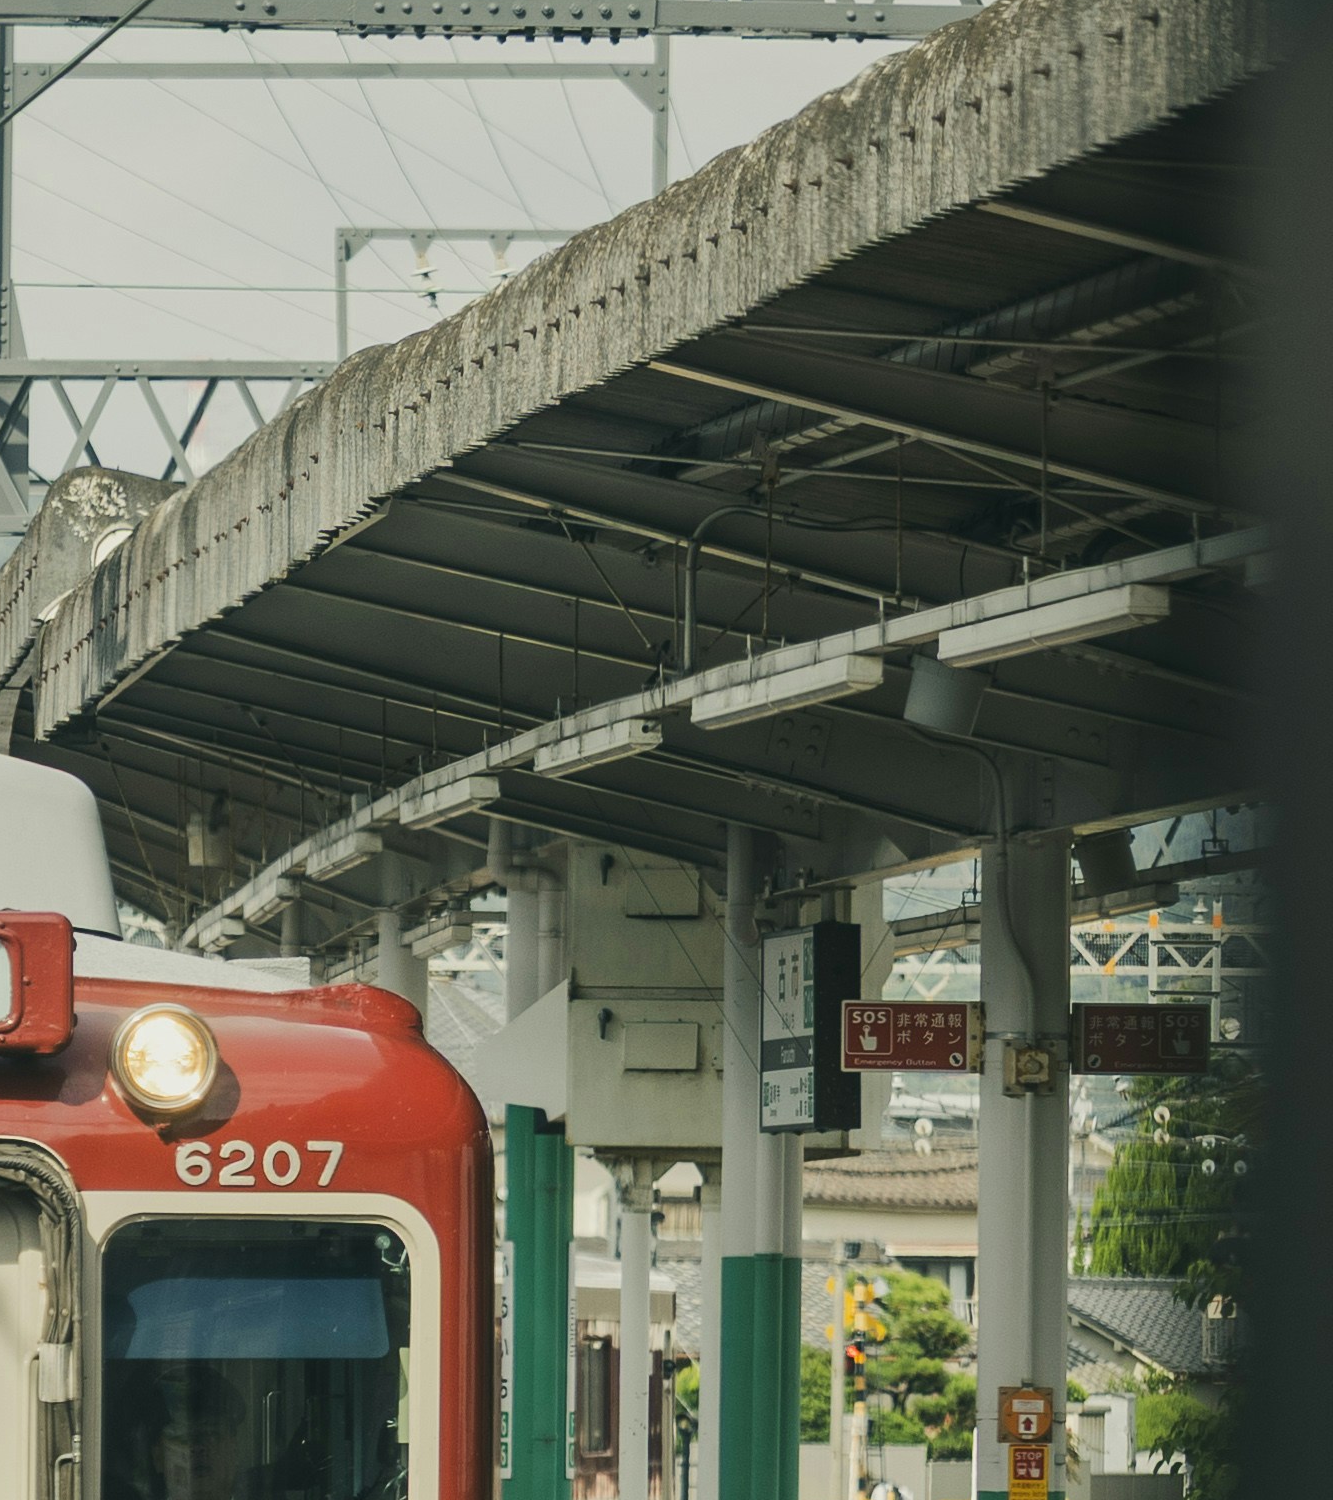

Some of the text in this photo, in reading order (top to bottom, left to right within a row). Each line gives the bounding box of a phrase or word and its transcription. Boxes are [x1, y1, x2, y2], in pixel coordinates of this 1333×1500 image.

[852, 1011, 887, 1024] SOS
[896, 1013, 963, 1029] 非常通報
[1089, 1015, 1156, 1030] 非常通報
[1165, 1015, 1200, 1028] SOS
[896, 1030, 961, 1045] ボタン
[1089, 1032, 1154, 1047] ボタン
[854, 1058, 937, 1067] Emergency Button
[175, 1139, 344, 1187] 6207
[1014, 1451, 1042, 1461] STOP
